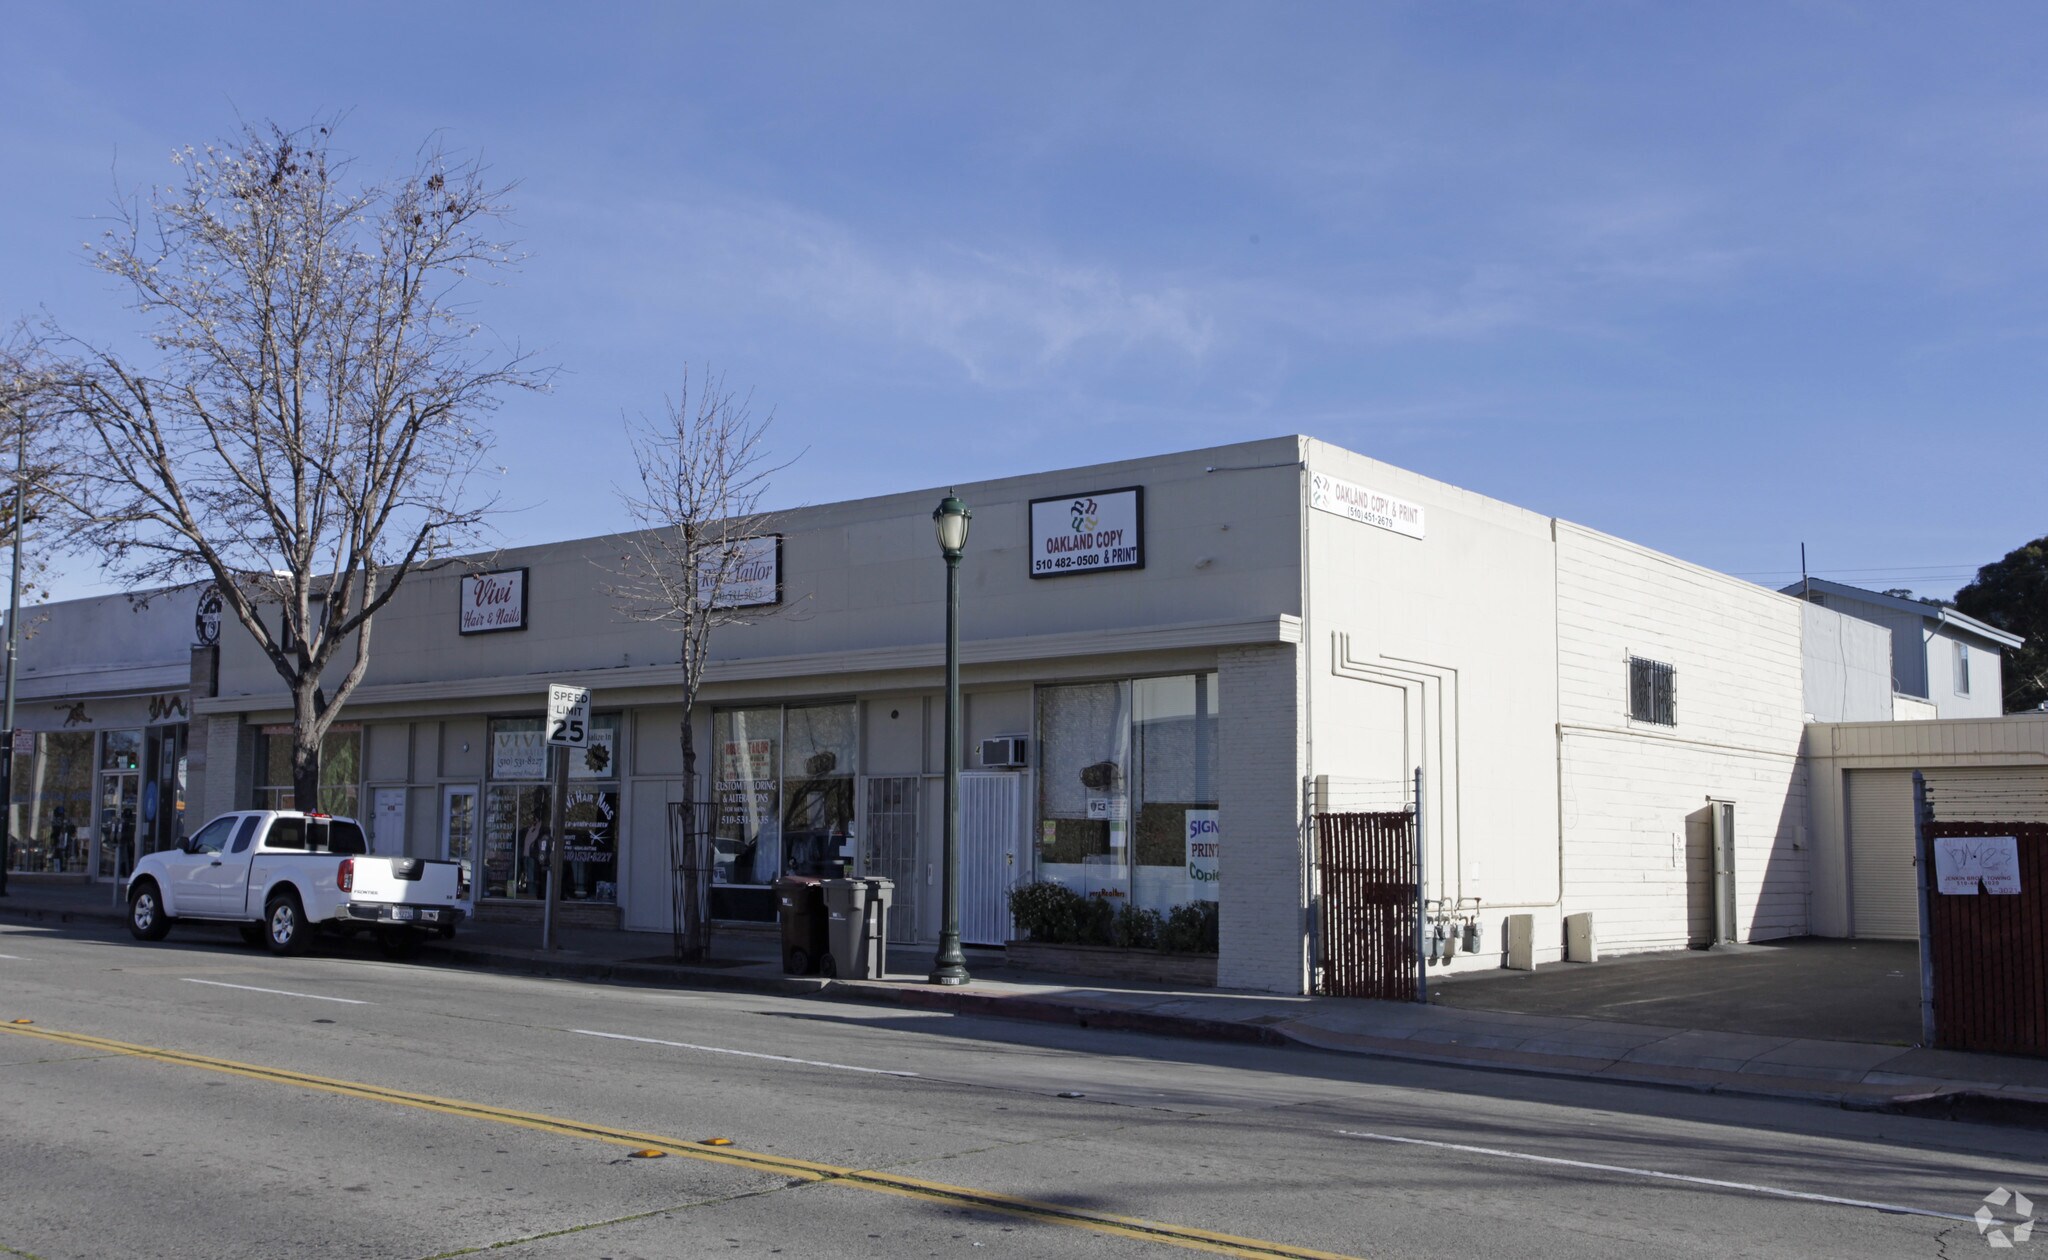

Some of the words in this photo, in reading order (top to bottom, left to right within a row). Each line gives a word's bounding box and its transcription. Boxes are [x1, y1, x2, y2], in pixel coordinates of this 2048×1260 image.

[1335, 484, 1368, 508] OAKLAND
[1371, 495, 1389, 514] COPY
[1392, 502, 1397, 517] &
[1399, 504, 1418, 524] PRINT
[1046, 533, 1094, 554] OAKLAND
[1096, 529, 1123, 548] COPY
[1036, 559, 1052, 570] 510
[1055, 554, 1099, 568] 482-0500
[1104, 550, 1109, 564] &
[1112, 547, 1137, 563] PRINT
[473, 578, 513, 607] Vivi
[463, 610, 484, 628] Hair
[487, 612, 493, 624] &
[496, 606, 520, 625] Nails
[553, 691, 588, 703] SPEED
[556, 705, 583, 716] LIMIT
[551, 719, 584, 742] 25
[716, 781, 742, 791] CUSTOM
